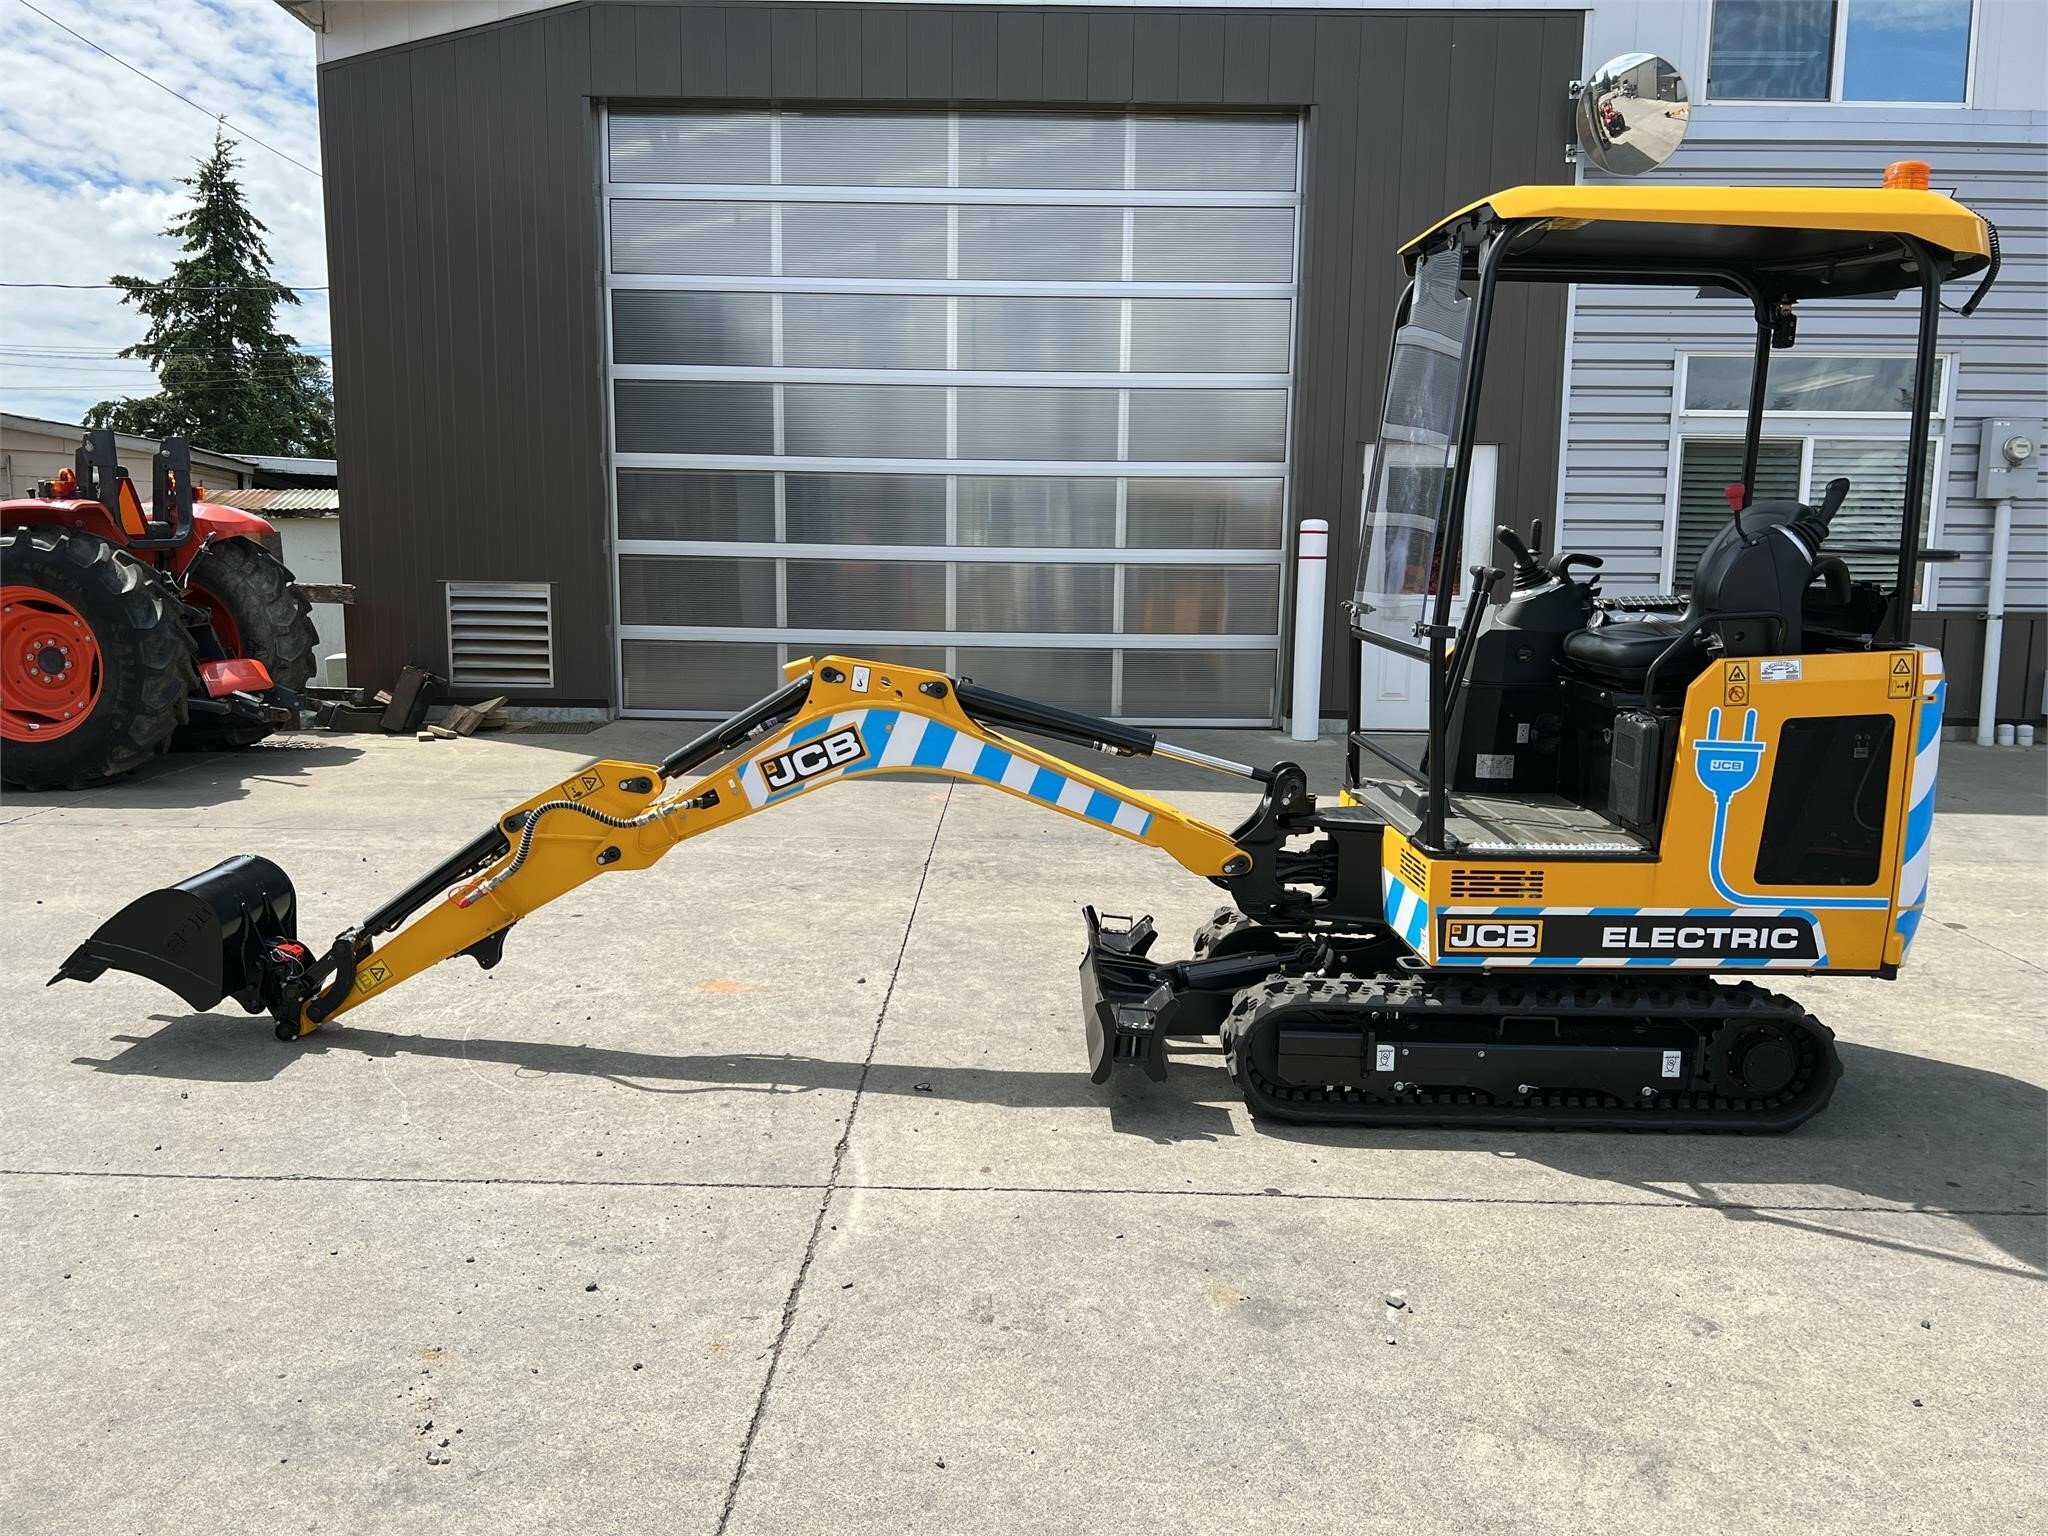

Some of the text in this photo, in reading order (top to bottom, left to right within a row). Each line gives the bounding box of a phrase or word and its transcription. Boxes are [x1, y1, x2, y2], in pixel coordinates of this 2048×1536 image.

[768, 731, 861, 787] JCB
[1712, 761, 1742, 770] JCB
[1450, 924, 1799, 949] JCB ELECTRIC
